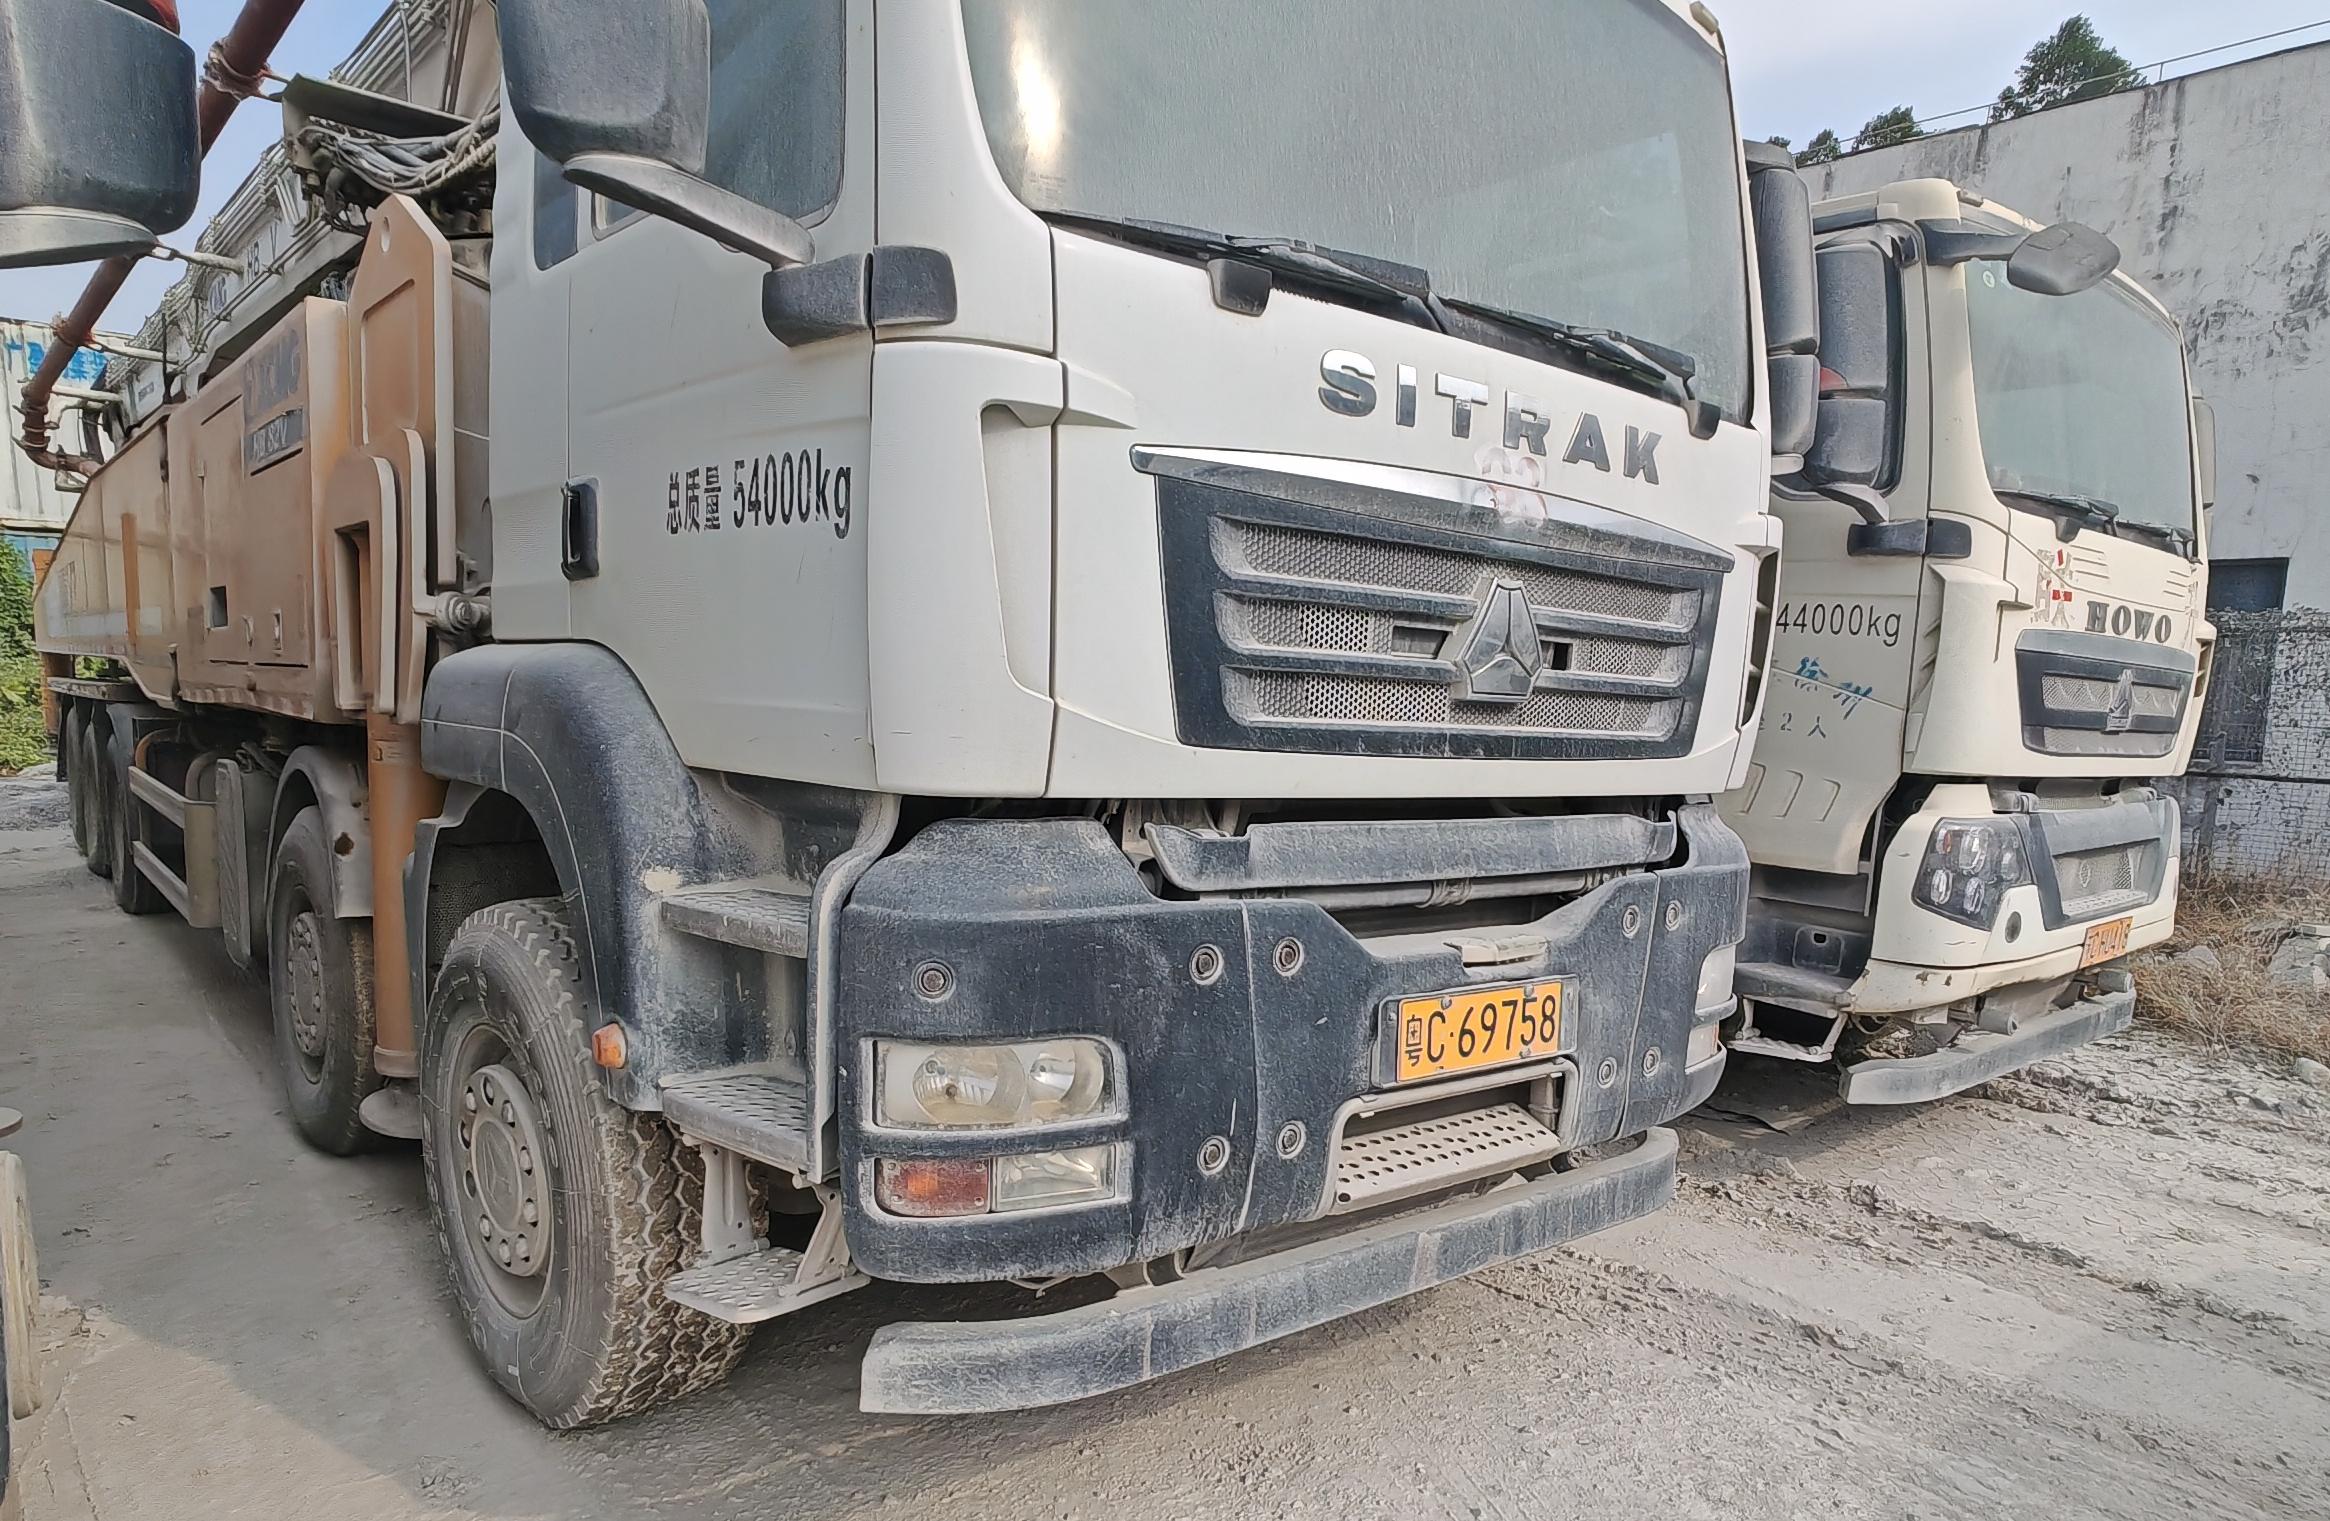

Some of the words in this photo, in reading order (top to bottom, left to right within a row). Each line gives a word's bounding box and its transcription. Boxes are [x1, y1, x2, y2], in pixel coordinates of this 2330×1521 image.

[1318, 348, 1662, 485] SITRAK
[666, 464, 721, 535] 总质量
[733, 448, 852, 540] 54000kg
[1776, 603, 1901, 647] 44000kg
[2085, 600, 2172, 643] HOWO
